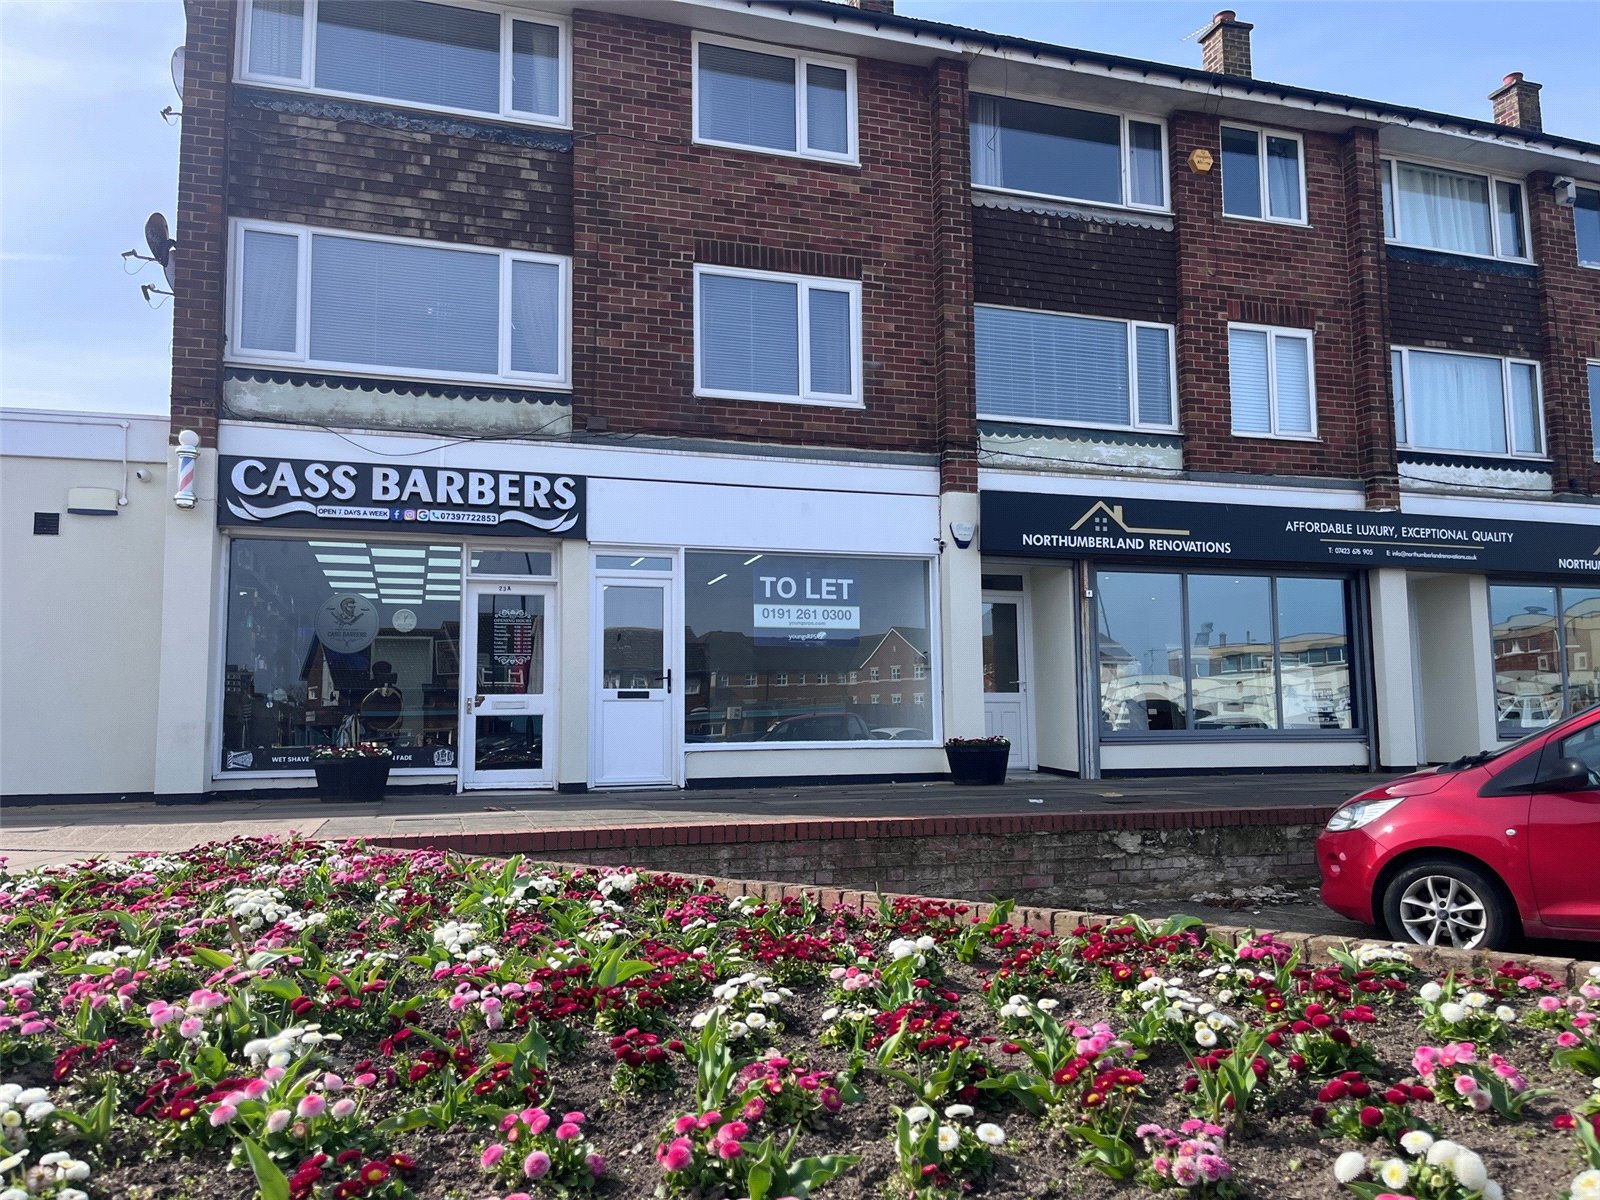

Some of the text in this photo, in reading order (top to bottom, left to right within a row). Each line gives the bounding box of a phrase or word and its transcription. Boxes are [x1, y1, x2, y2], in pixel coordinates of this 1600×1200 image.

[230, 459, 578, 510] CASS BARBERS
[440, 512, 497, 523] 07397722853
[1285, 520, 1514, 544] AFFORDABLE LUXURY, EXCEPTIONAL QUALITY
[1022, 533, 1232, 554] NORTHUMBERLAND RENOVATIONS
[1558, 558, 1600, 570] NORTHU
[759, 576, 854, 600] TO LET
[761, 607, 852, 621] 0191 261 0300
